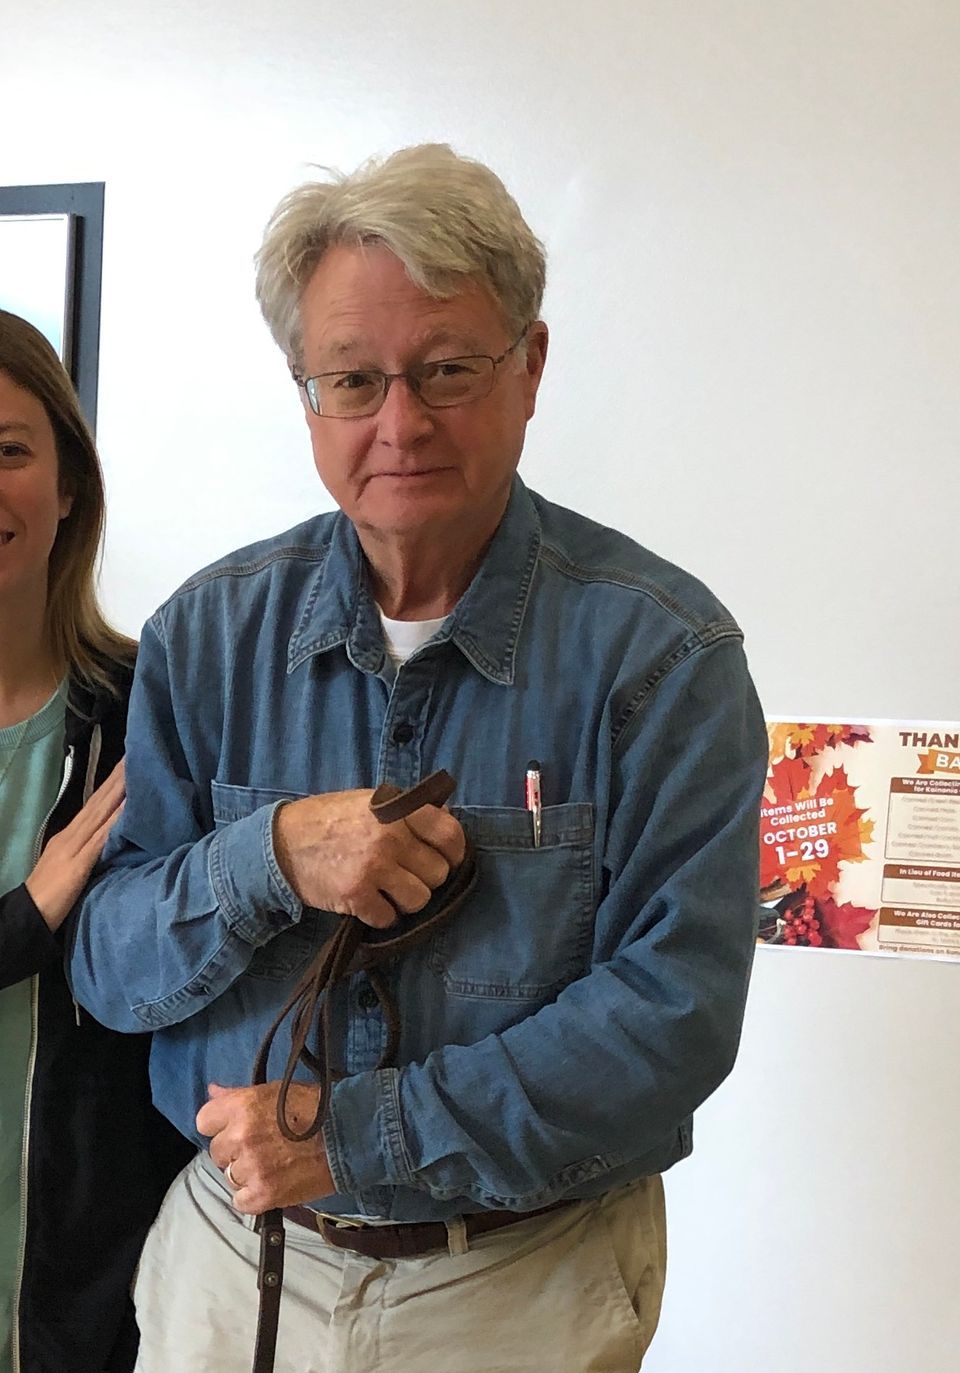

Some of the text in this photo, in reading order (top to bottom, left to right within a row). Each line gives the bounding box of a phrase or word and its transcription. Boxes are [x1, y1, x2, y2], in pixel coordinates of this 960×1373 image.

[899, 732, 959, 748] THAN
[760, 797, 834, 818] Items Will Be
[770, 808, 826, 826] Collected
[763, 822, 837, 845] OCTOBER
